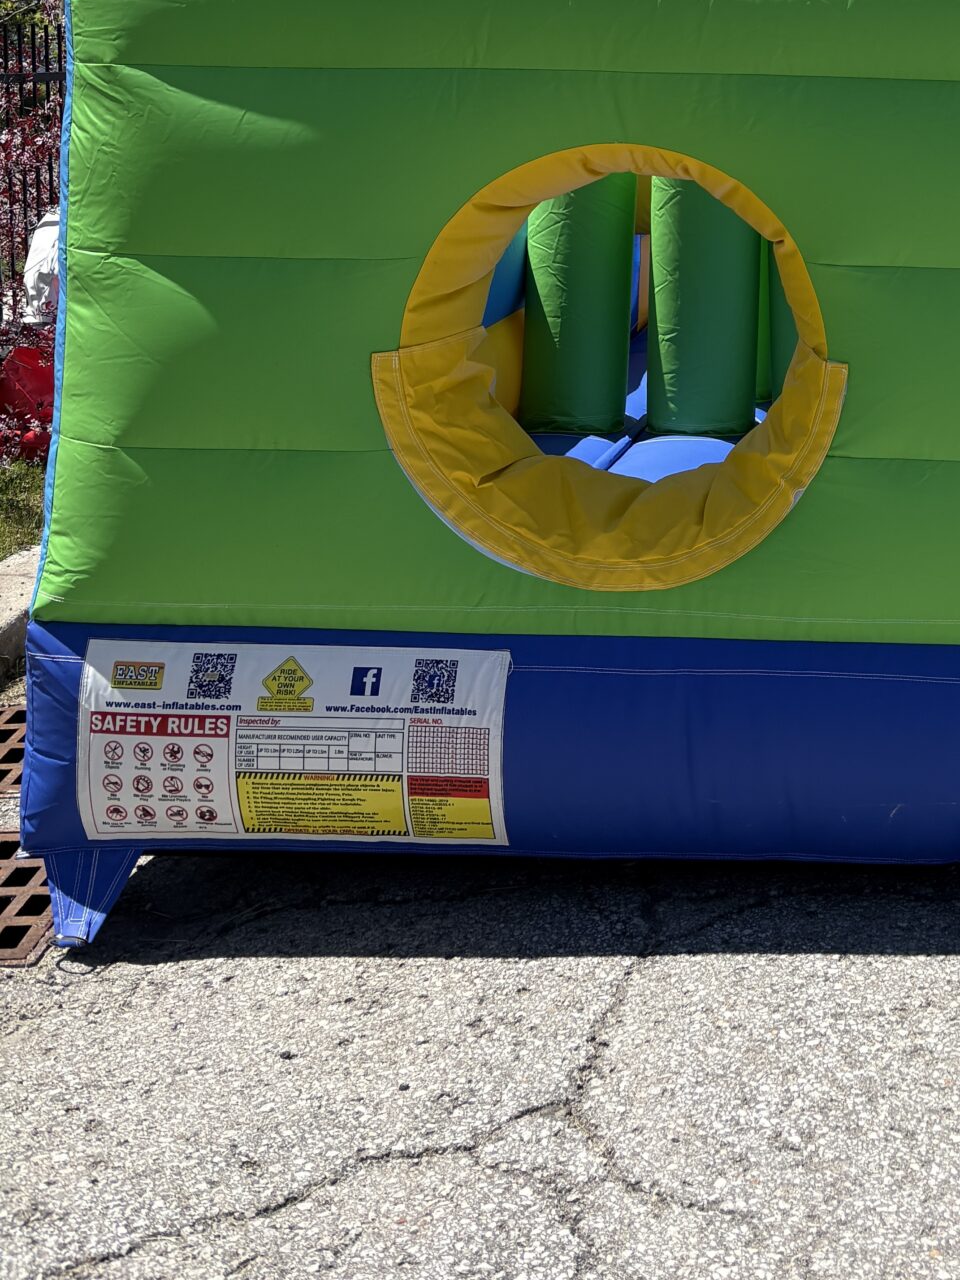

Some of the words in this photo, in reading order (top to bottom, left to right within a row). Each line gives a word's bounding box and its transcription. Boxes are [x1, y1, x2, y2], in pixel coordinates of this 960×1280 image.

[115, 665, 161, 681] EAST
[105, 700, 242, 712] www.east-inflatables.com
[325, 704, 477, 716] www.Facebook.com/EastInflatables
[91, 714, 162, 734] SAFETY
[167, 716, 228, 735] RULES
[239, 717, 271, 727] Inspected
[409, 717, 431, 725] SERIAL
